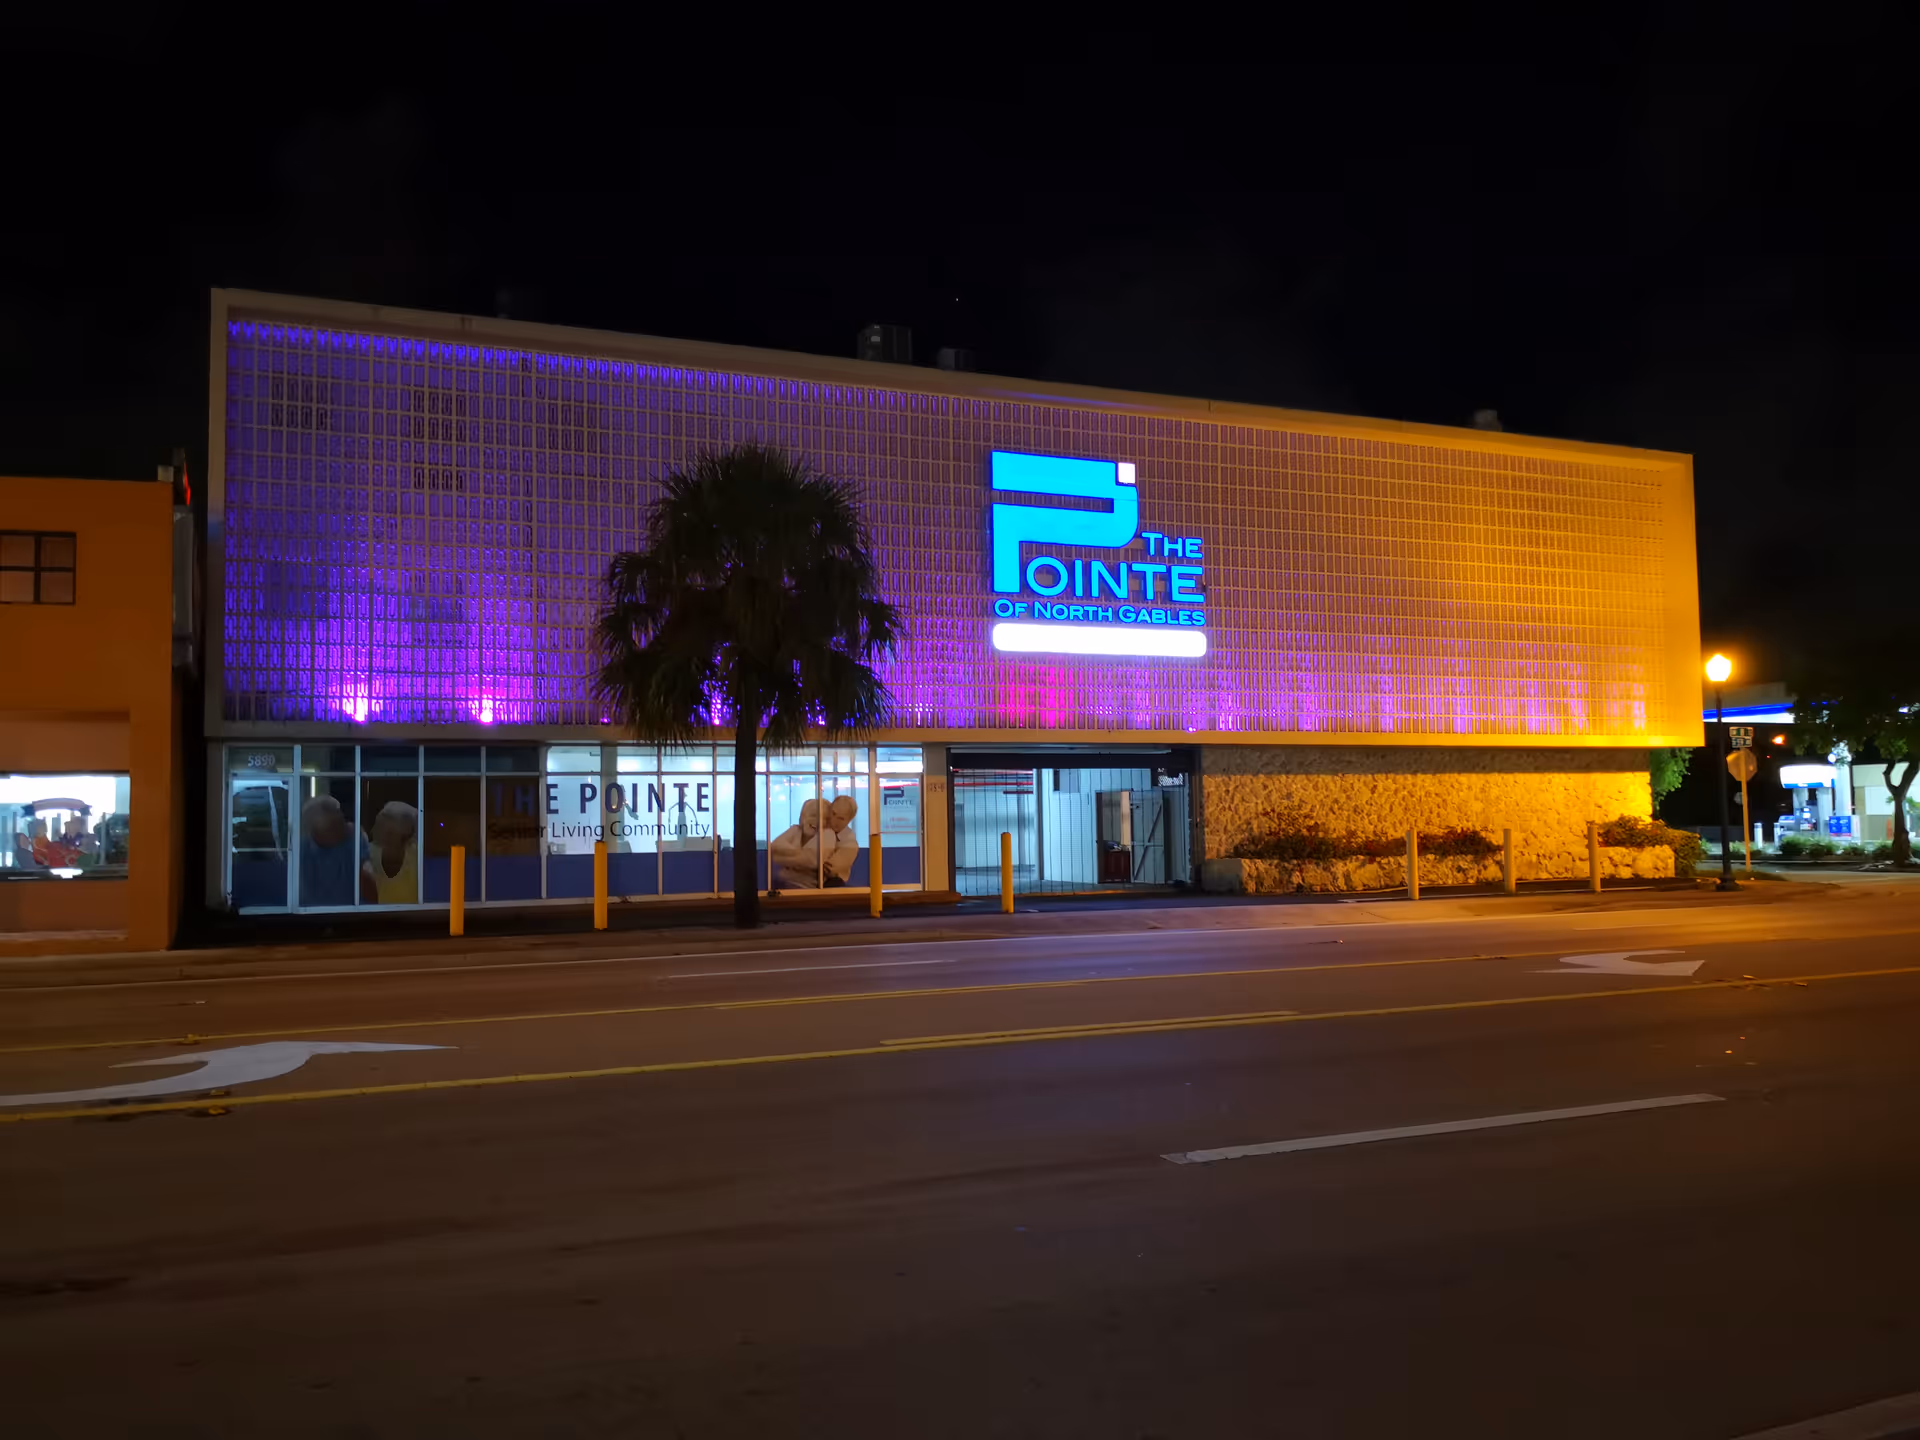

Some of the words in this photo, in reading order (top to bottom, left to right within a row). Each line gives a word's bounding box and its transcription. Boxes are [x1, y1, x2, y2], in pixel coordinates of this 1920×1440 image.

[1141, 531, 1204, 559] THE
[1033, 601, 1114, 623] NORTH
[1117, 604, 1206, 626] GABLES
[247, 754, 276, 767] 5890
[491, 783, 559, 816] THE
[579, 782, 710, 814] POINTE
[552, 822, 605, 842] Living
[609, 820, 710, 840] Community
